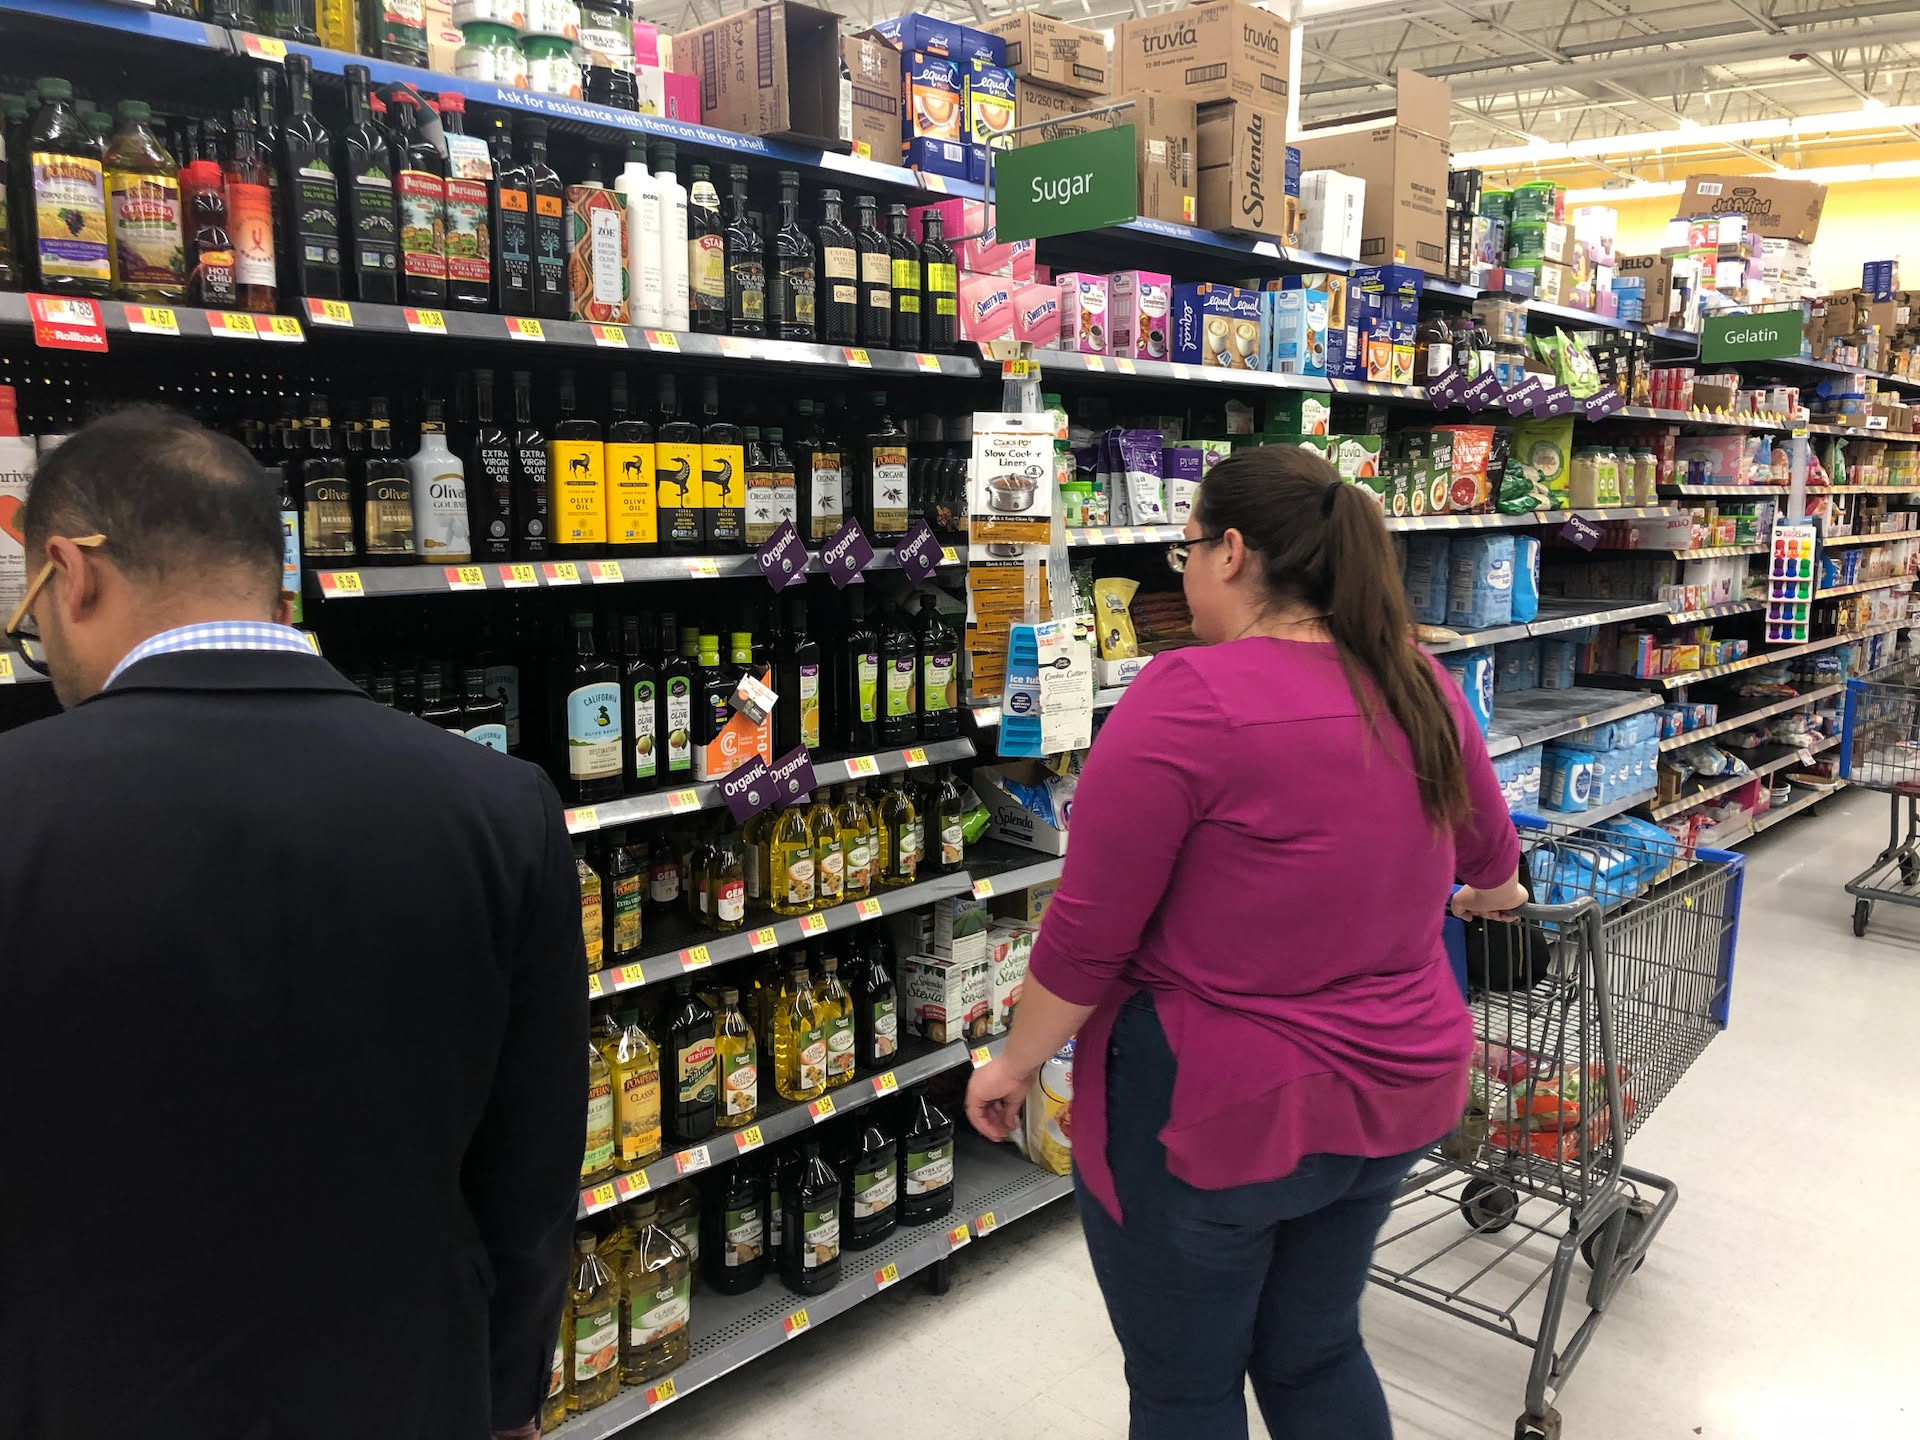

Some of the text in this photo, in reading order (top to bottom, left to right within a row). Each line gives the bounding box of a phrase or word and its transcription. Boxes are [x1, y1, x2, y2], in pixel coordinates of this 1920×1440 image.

[591, 12, 612, 22] Great
[928, 37, 949, 49] equal
[731, 19, 746, 84] pyure
[914, 68, 957, 89] equal
[975, 76, 1014, 97] equal
[1025, 91, 1051, 108] 12/250
[497, 88, 523, 105] Ask
[525, 93, 546, 110] for
[547, 99, 613, 122] assistance
[615, 110, 641, 128] with
[643, 117, 678, 135] items
[680, 124, 696, 137] on
[697, 128, 716, 141] the
[717, 132, 738, 149] top
[1166, 136, 1178, 187] equal
[1242, 113, 1265, 228] Splenda
[402, 175, 442, 193] Partanna
[447, 182, 487, 199] Partanna
[1031, 172, 1093, 206] Sugar
[303, 191, 325, 200] OLIVE
[597, 227, 616, 238] ZOE
[1619, 257, 1654, 271] JELL-O
[208, 266, 229, 276] HOT
[206, 274, 233, 285] CHILI
[214, 285, 227, 293] OIL
[1204, 293, 1233, 313] equal
[1236, 296, 1262, 314] equal
[149, 310, 170, 325] 4.67
[1179, 301, 1198, 351] equal
[54, 331, 103, 345] Rollback
[1724, 329, 1778, 345] Gelatin
[1429, 368, 1460, 396] Organic
[1464, 373, 1496, 399] Organic
[1506, 381, 1540, 403] Organic
[1586, 390, 1619, 409] Organic
[482, 450, 508, 458] EXTRA
[520, 450, 545, 458] EXTRA
[984, 449, 1042, 458] Slow Cookr
[483, 458, 510, 466] VIRGIN
[521, 458, 547, 466] VIRGIN
[998, 458, 1027, 468] Liners
[486, 466, 510, 474] OLIVE
[524, 466, 547, 474] OLIVE
[496, 474, 510, 483] OIL
[534, 474, 547, 483] OIL
[1571, 517, 1600, 539] Organic
[762, 529, 796, 567] Organic
[824, 527, 859, 564] Organic
[900, 528, 931, 562] Organic
[463, 569, 481, 582] 6.96
[517, 567, 532, 580] 9.47
[559, 564, 575, 579] 9.47
[337, 575, 357, 589] 6.96
[1066, 669, 1088, 679] Cutters
[583, 693, 618, 707] CALIFORNIA
[637, 716, 654, 725] OLIVE
[670, 711, 689, 720] OLIVE
[640, 724, 651, 733] OIL
[673, 719, 685, 727] OIL
[770, 752, 809, 784] Organic
[724, 763, 767, 797] Organic
[995, 807, 1034, 829] Splenda
[656, 870, 677, 881] GEM
[725, 888, 743, 899] GEM
[616, 898, 630, 908] EXTRA
[693, 948, 707, 960] 4.12
[626, 967, 641, 979] 4.12
[907, 982, 945, 1003] Stevia
[687, 1047, 714, 1063] BERTOLLI
[735, 1055, 750, 1063] Great
[624, 1071, 659, 1092] POMPEIAN
[630, 1088, 656, 1103] CLASSIC
[927, 1148, 943, 1159] Great
[874, 1168, 889, 1178] Great
[916, 1166, 933, 1177] EXTRA
[864, 1187, 881, 1199] EXTRA
[740, 1209, 757, 1220] Great
[819, 1209, 834, 1220] Great
[656, 1286, 674, 1299] Great
[594, 1312, 612, 1325] Great
